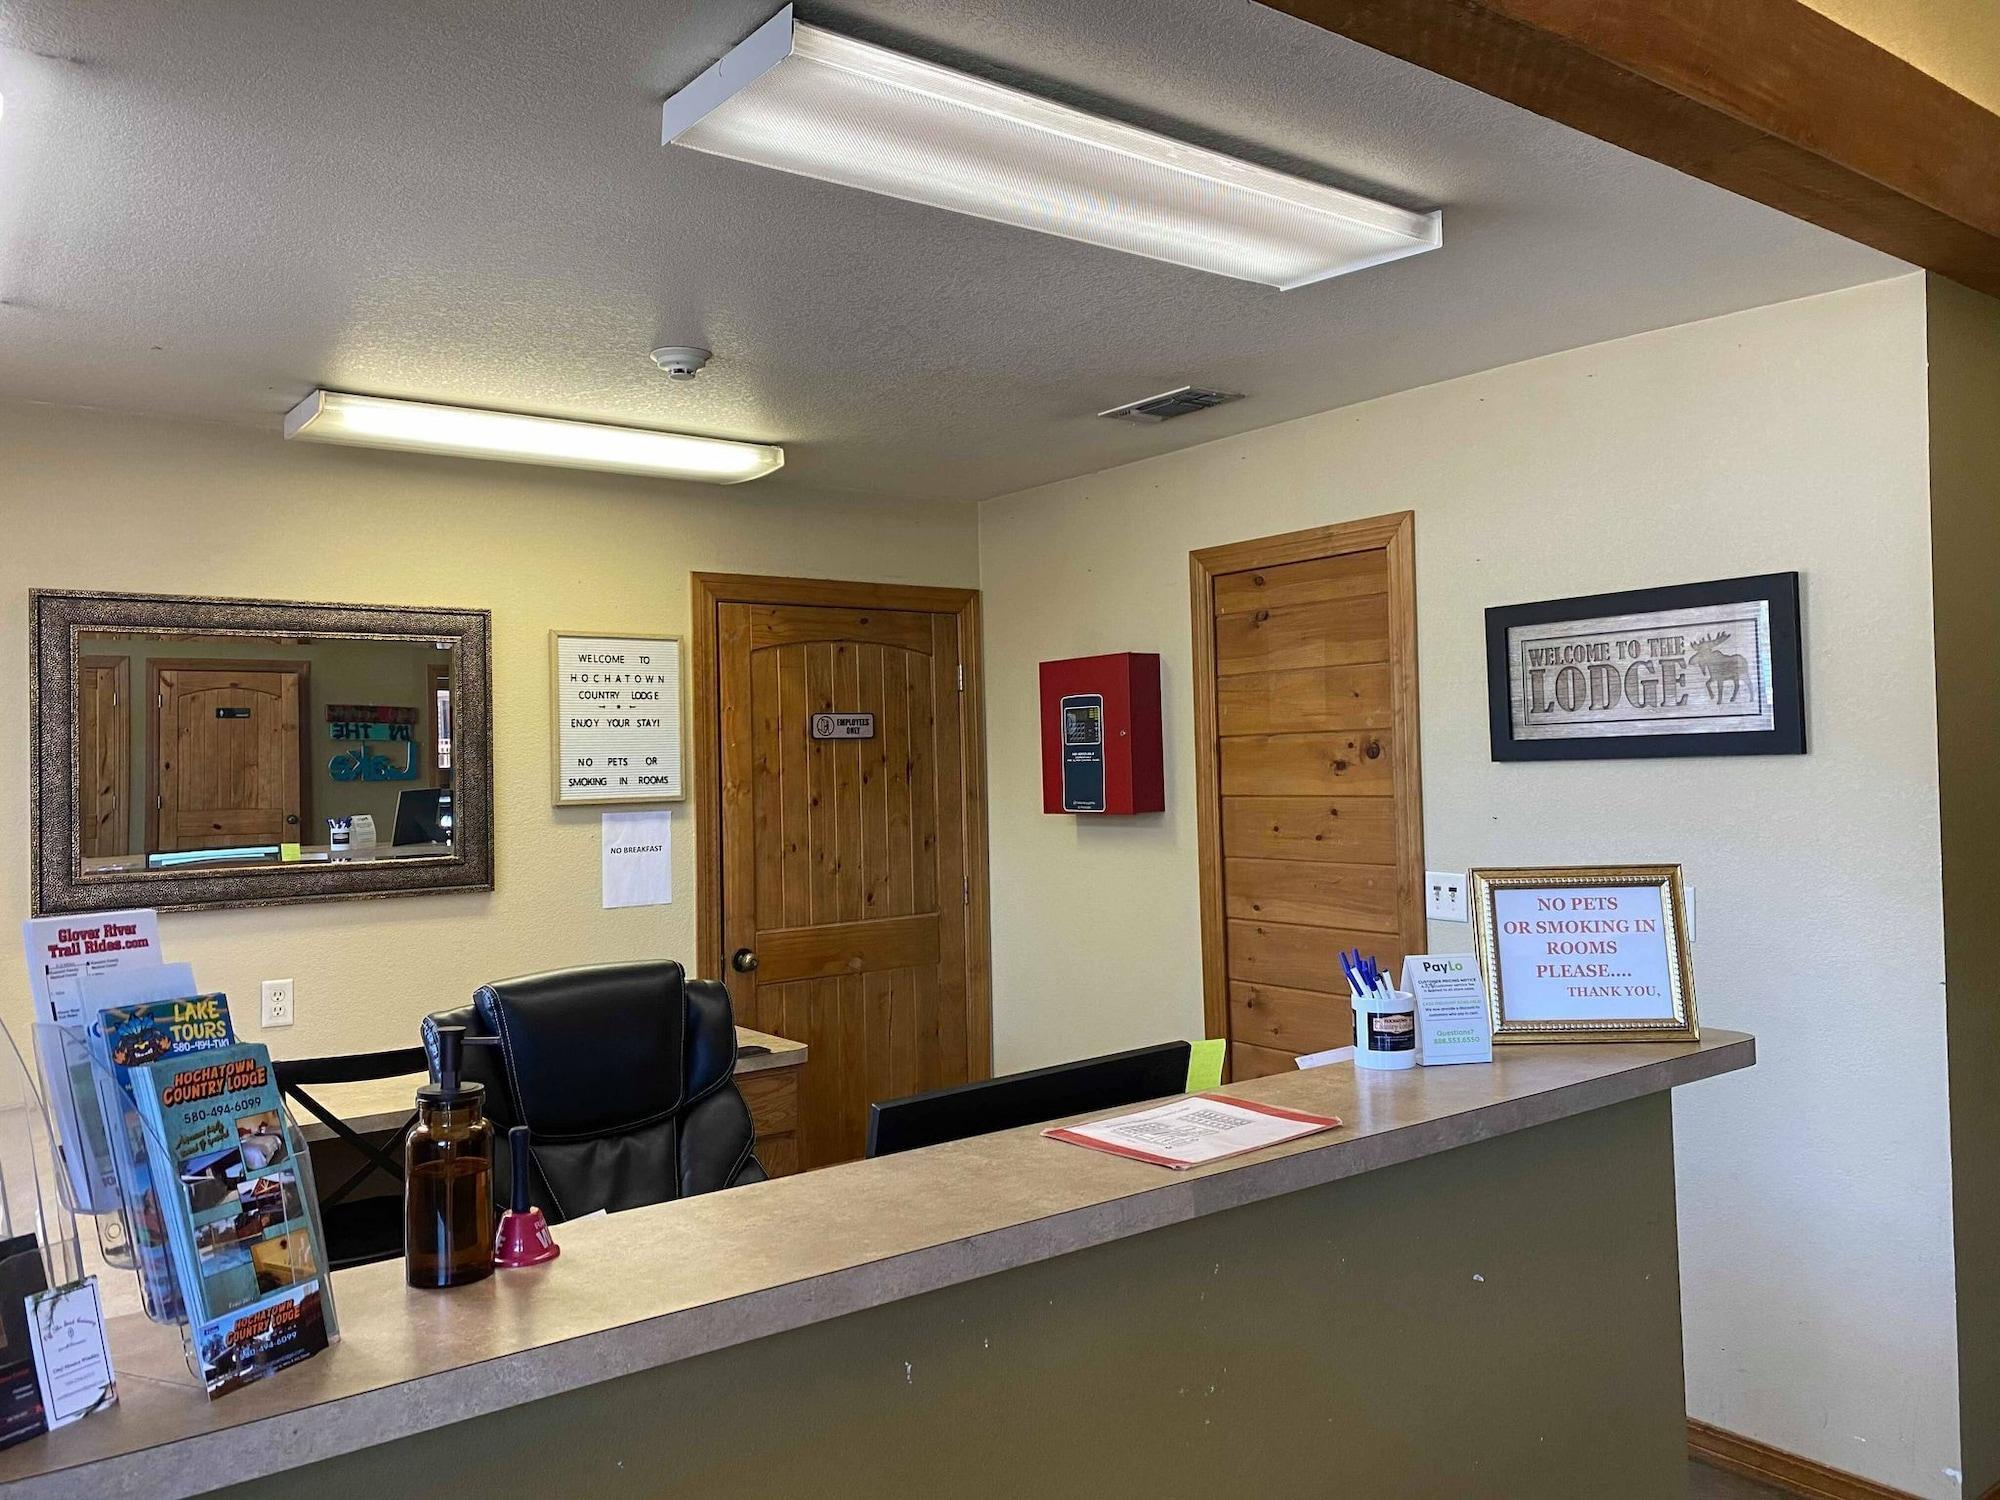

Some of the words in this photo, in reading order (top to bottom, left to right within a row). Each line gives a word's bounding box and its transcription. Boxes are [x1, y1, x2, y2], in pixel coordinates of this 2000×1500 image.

[1528, 642, 1610, 667] WELCOME
[1616, 638, 1641, 659] TO
[1647, 636, 1685, 656] THE
[578, 654, 625, 664] WELCOME
[639, 656, 650, 664] TO
[570, 674, 665, 683] HOCHATOWN
[1529, 658, 1687, 714] LODGE
[578, 691, 620, 700] COUNTRY
[631, 691, 659, 700] LODGE
[571, 719, 600, 728] ENJOY
[607, 719, 630, 727] YOUR
[637, 719, 660, 727] STAY!
[837, 718, 869, 726] EMPLOYEES
[846, 727, 861, 735] ONLY
[578, 758, 593, 766] NO
[607, 757, 628, 766] PETS
[645, 757, 657, 765] OR
[568, 777, 607, 786] SMOKING
[619, 777, 628, 785] IN
[638, 776, 669, 784] ROOMS
[623, 845, 662, 854] BREAKFAST
[1537, 898, 1566, 911] NO
[1571, 897, 1618, 910] PETS
[58, 928, 100, 943] Glover
[103, 924, 137, 938] River
[1503, 920, 1532, 935] OR
[1536, 919, 1629, 934] SMOKING
[1634, 919, 1656, 932] IN
[48, 942, 81, 958] Trail
[85, 938, 149, 954] Rides.com
[1546, 940, 1617, 955] ROOMS
[1423, 961, 1463, 974] PayLo
[1536, 964, 1632, 978] PLEASE....
[1567, 986, 1622, 997] THANK
[173, 1000, 220, 1022] LAKE
[170, 1020, 226, 1042] TOURS
[1437, 1029, 1474, 1037] Questions?
[174, 1059, 255, 1087] HOCHATOWN
[163, 1078, 224, 1106] COUNTRY
[227, 1066, 267, 1091] LODGE
[184, 1097, 261, 1124] 580-494-6099
[234, 1299, 294, 1331] HOCHATOWN
[225, 1319, 269, 1346] COUNTRY
